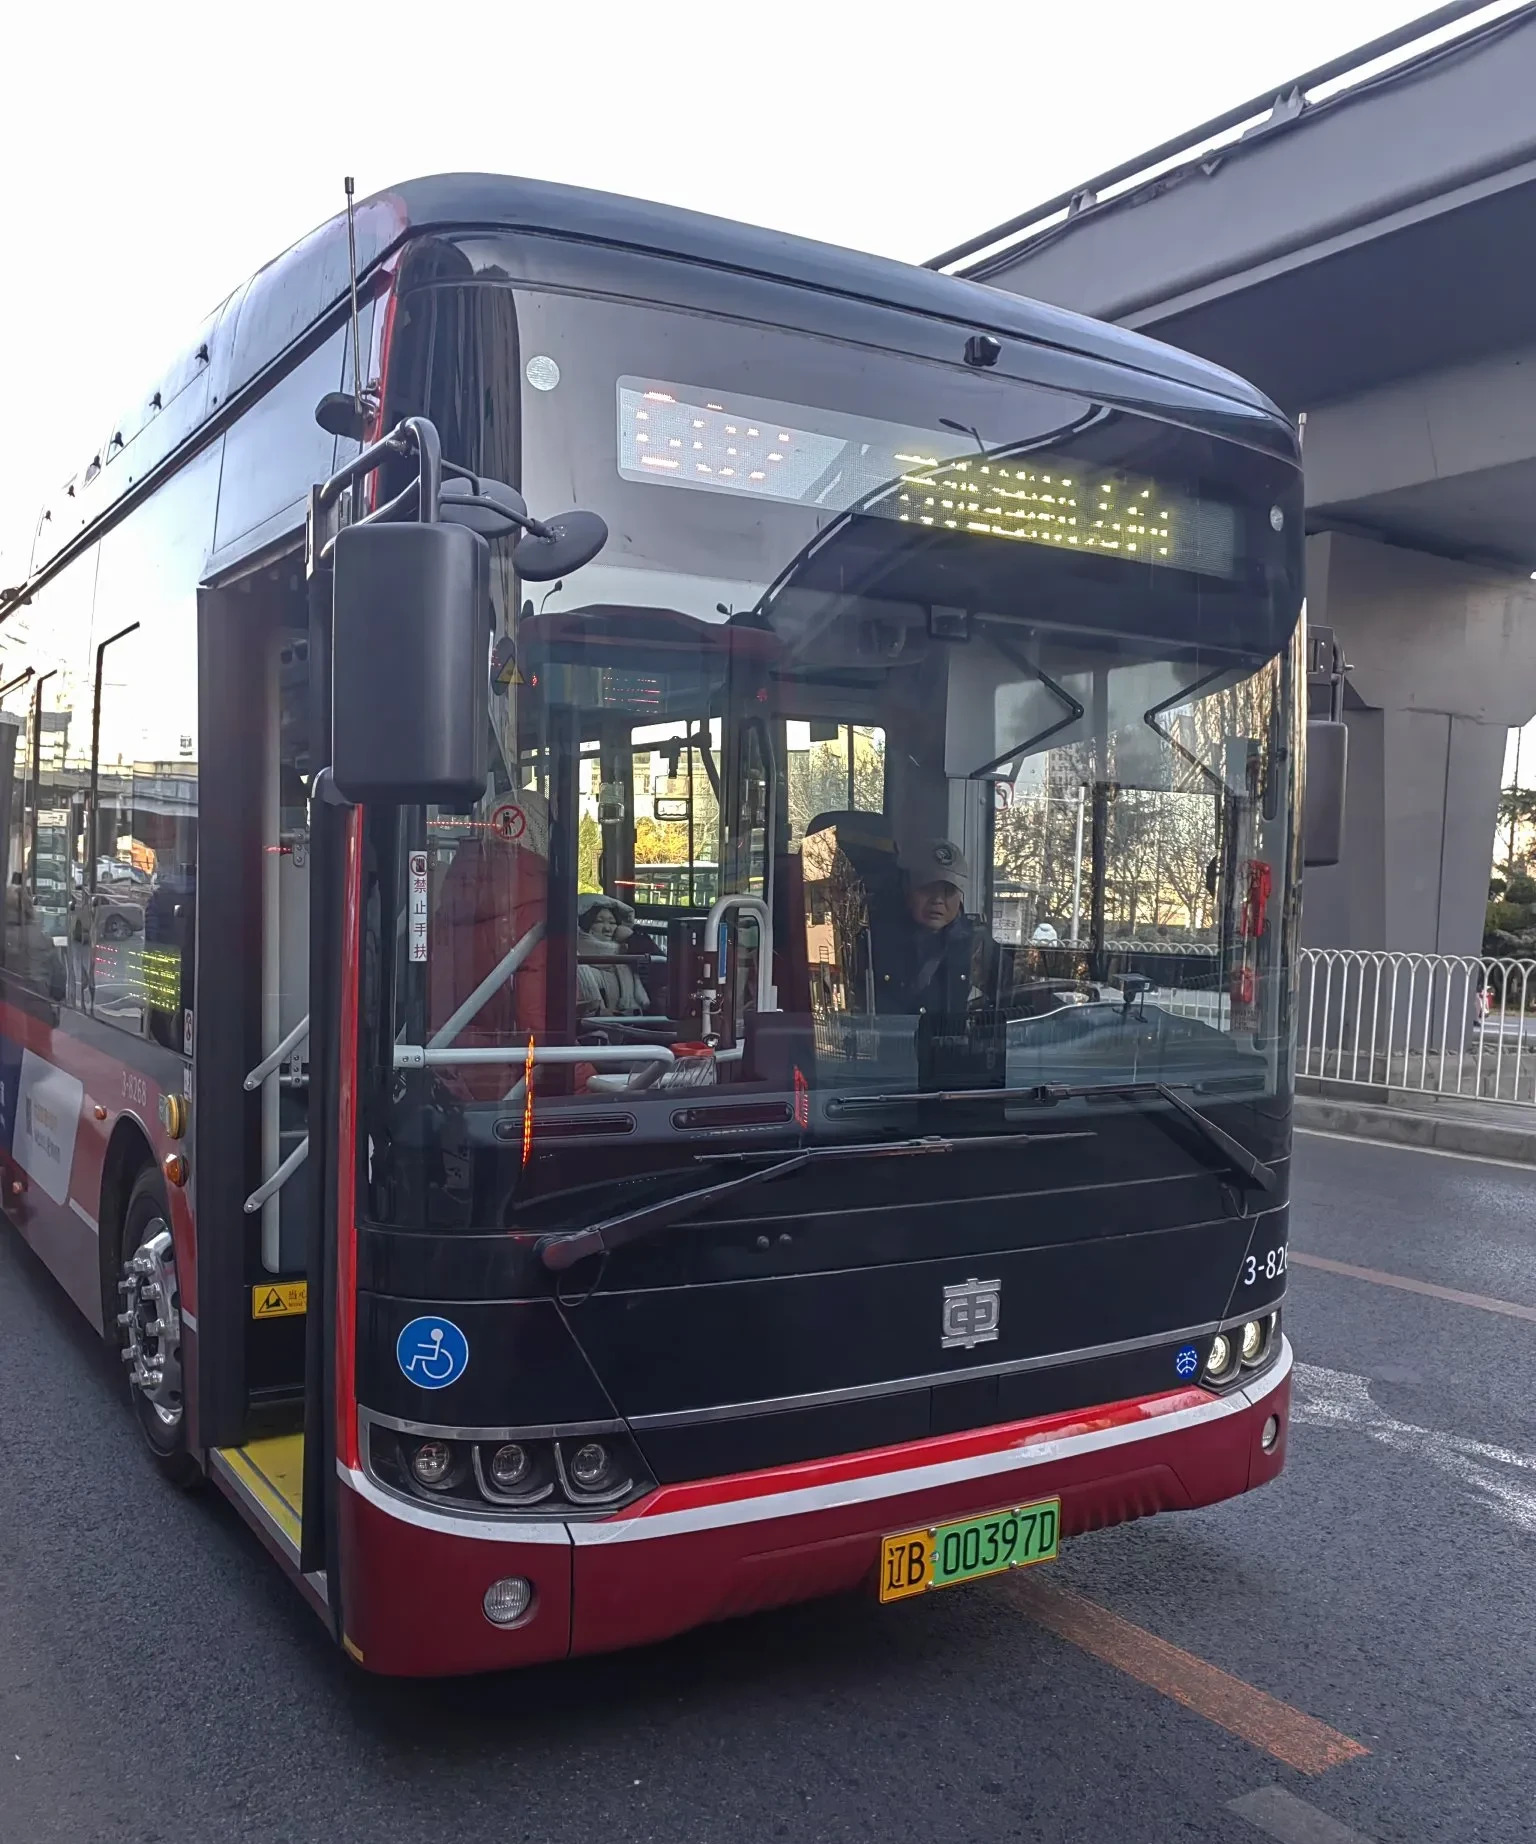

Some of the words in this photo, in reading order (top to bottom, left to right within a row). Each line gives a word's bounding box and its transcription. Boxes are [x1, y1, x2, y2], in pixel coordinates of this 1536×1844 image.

[413, 878, 427, 959] 禁止手扶
[887, 1541, 926, 1591] 辽B
[942, 1509, 1056, 1576] 00397D
